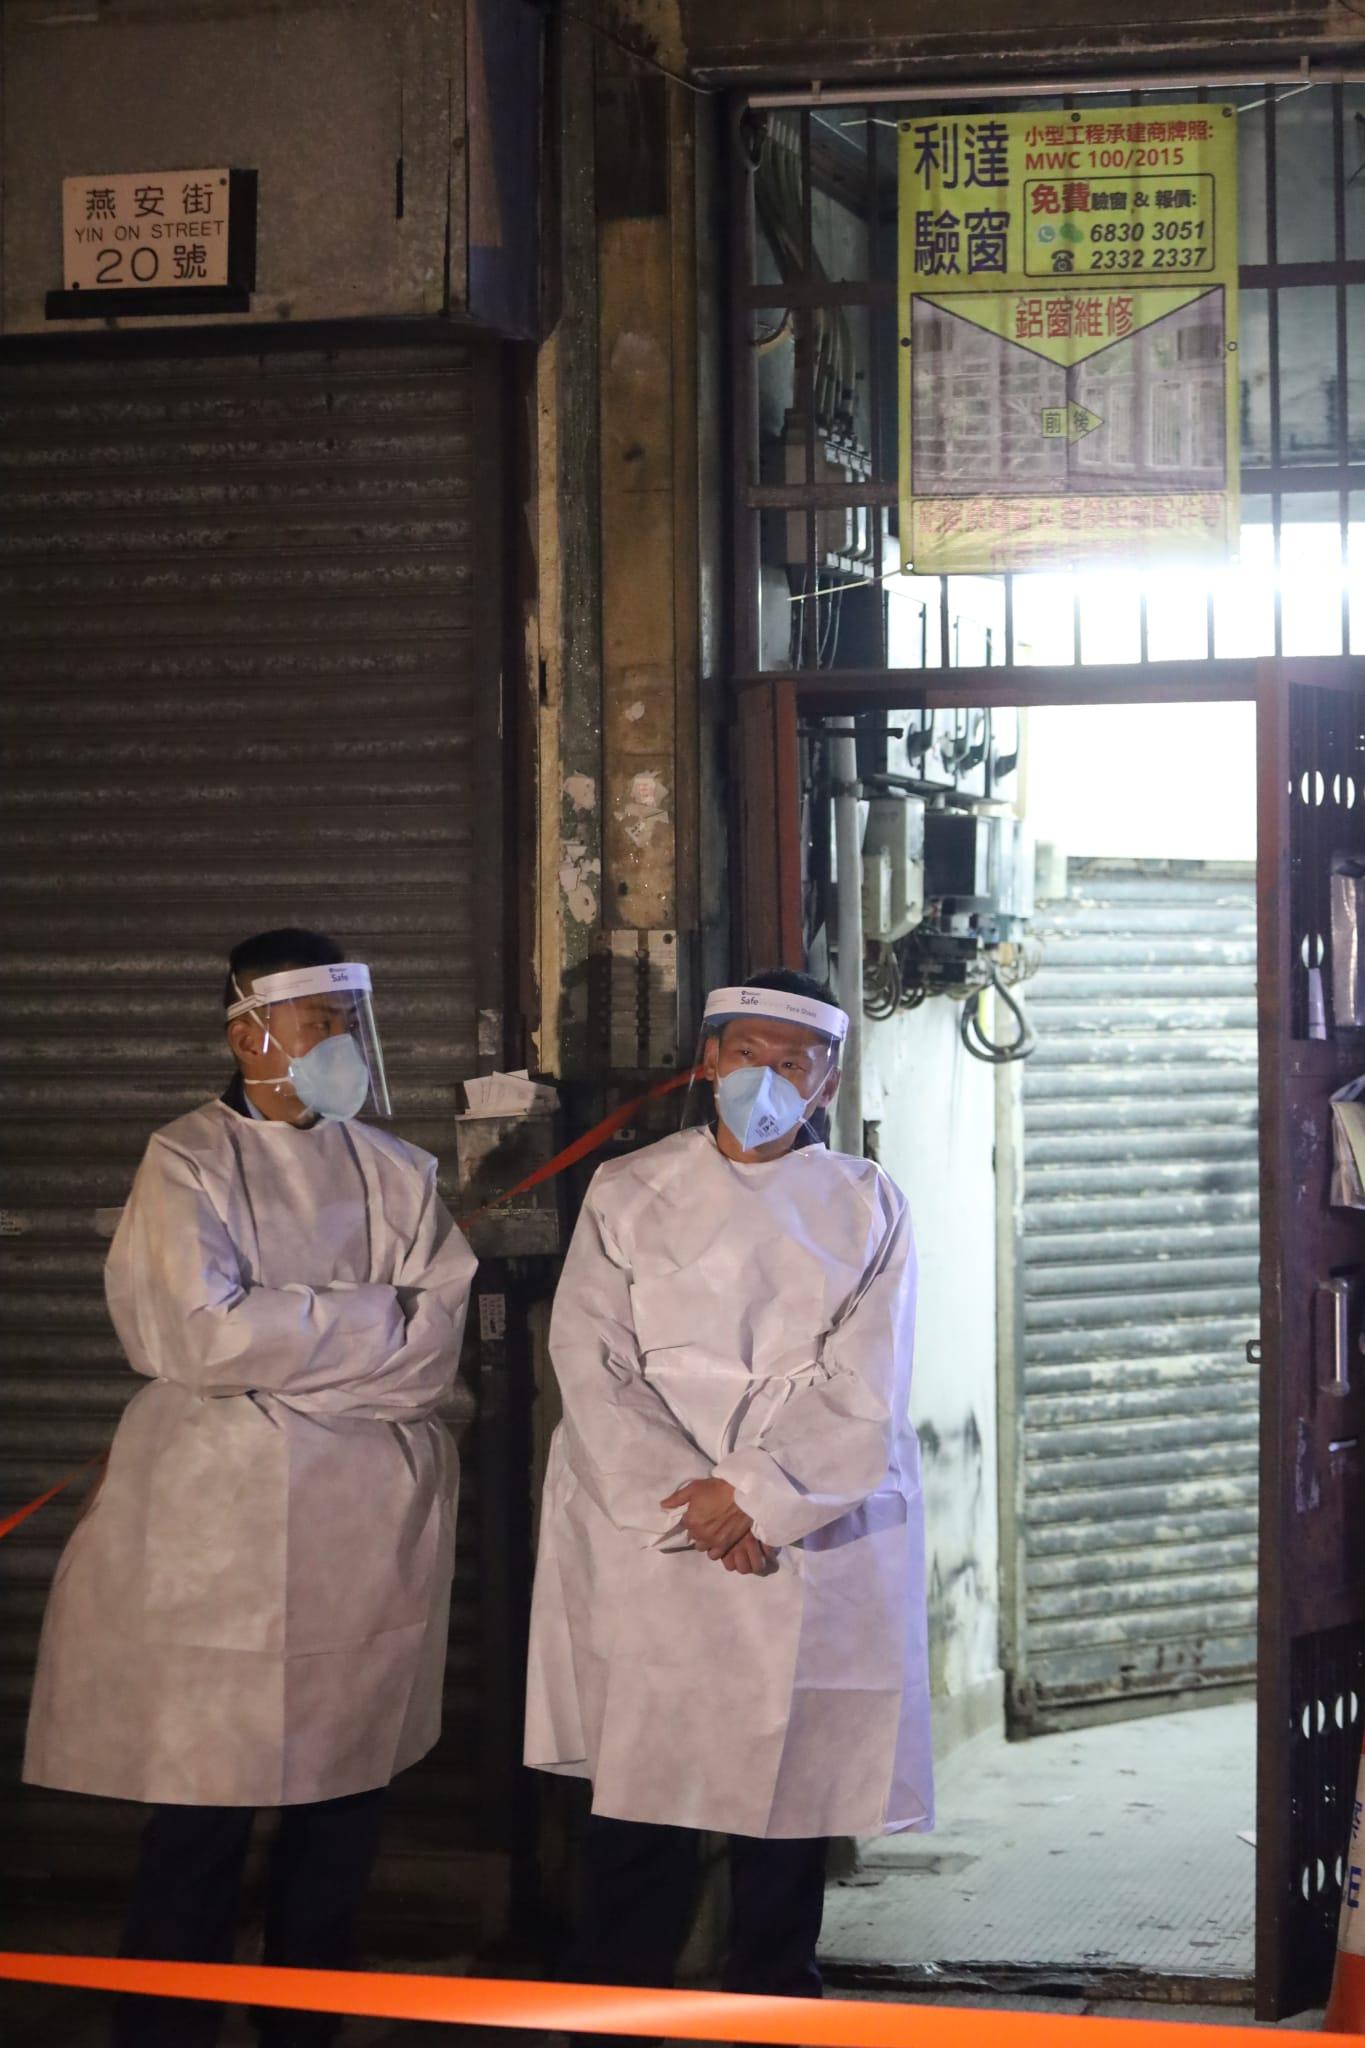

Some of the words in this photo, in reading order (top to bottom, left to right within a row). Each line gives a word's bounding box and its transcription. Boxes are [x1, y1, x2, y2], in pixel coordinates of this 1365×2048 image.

[914, 120, 1010, 190] 利達
[1025, 151, 1081, 170] MWC
[1088, 147, 1184, 169] 100/2015
[86, 183, 213, 220] 燕安街
[1134, 192, 1150, 208] &
[75, 227, 103, 243] YIN
[114, 225, 140, 240] ON
[151, 220, 225, 239] STREET
[914, 207, 1010, 276] 驗窗
[1090, 222, 1145, 243] 6830
[1152, 220, 1206, 241] 3051
[1090, 250, 1145, 270] 2332
[1152, 247, 1207, 268] 2337
[1015, 296, 1134, 339] 鋁窗維修
[740, 996, 759, 1006] Safe
